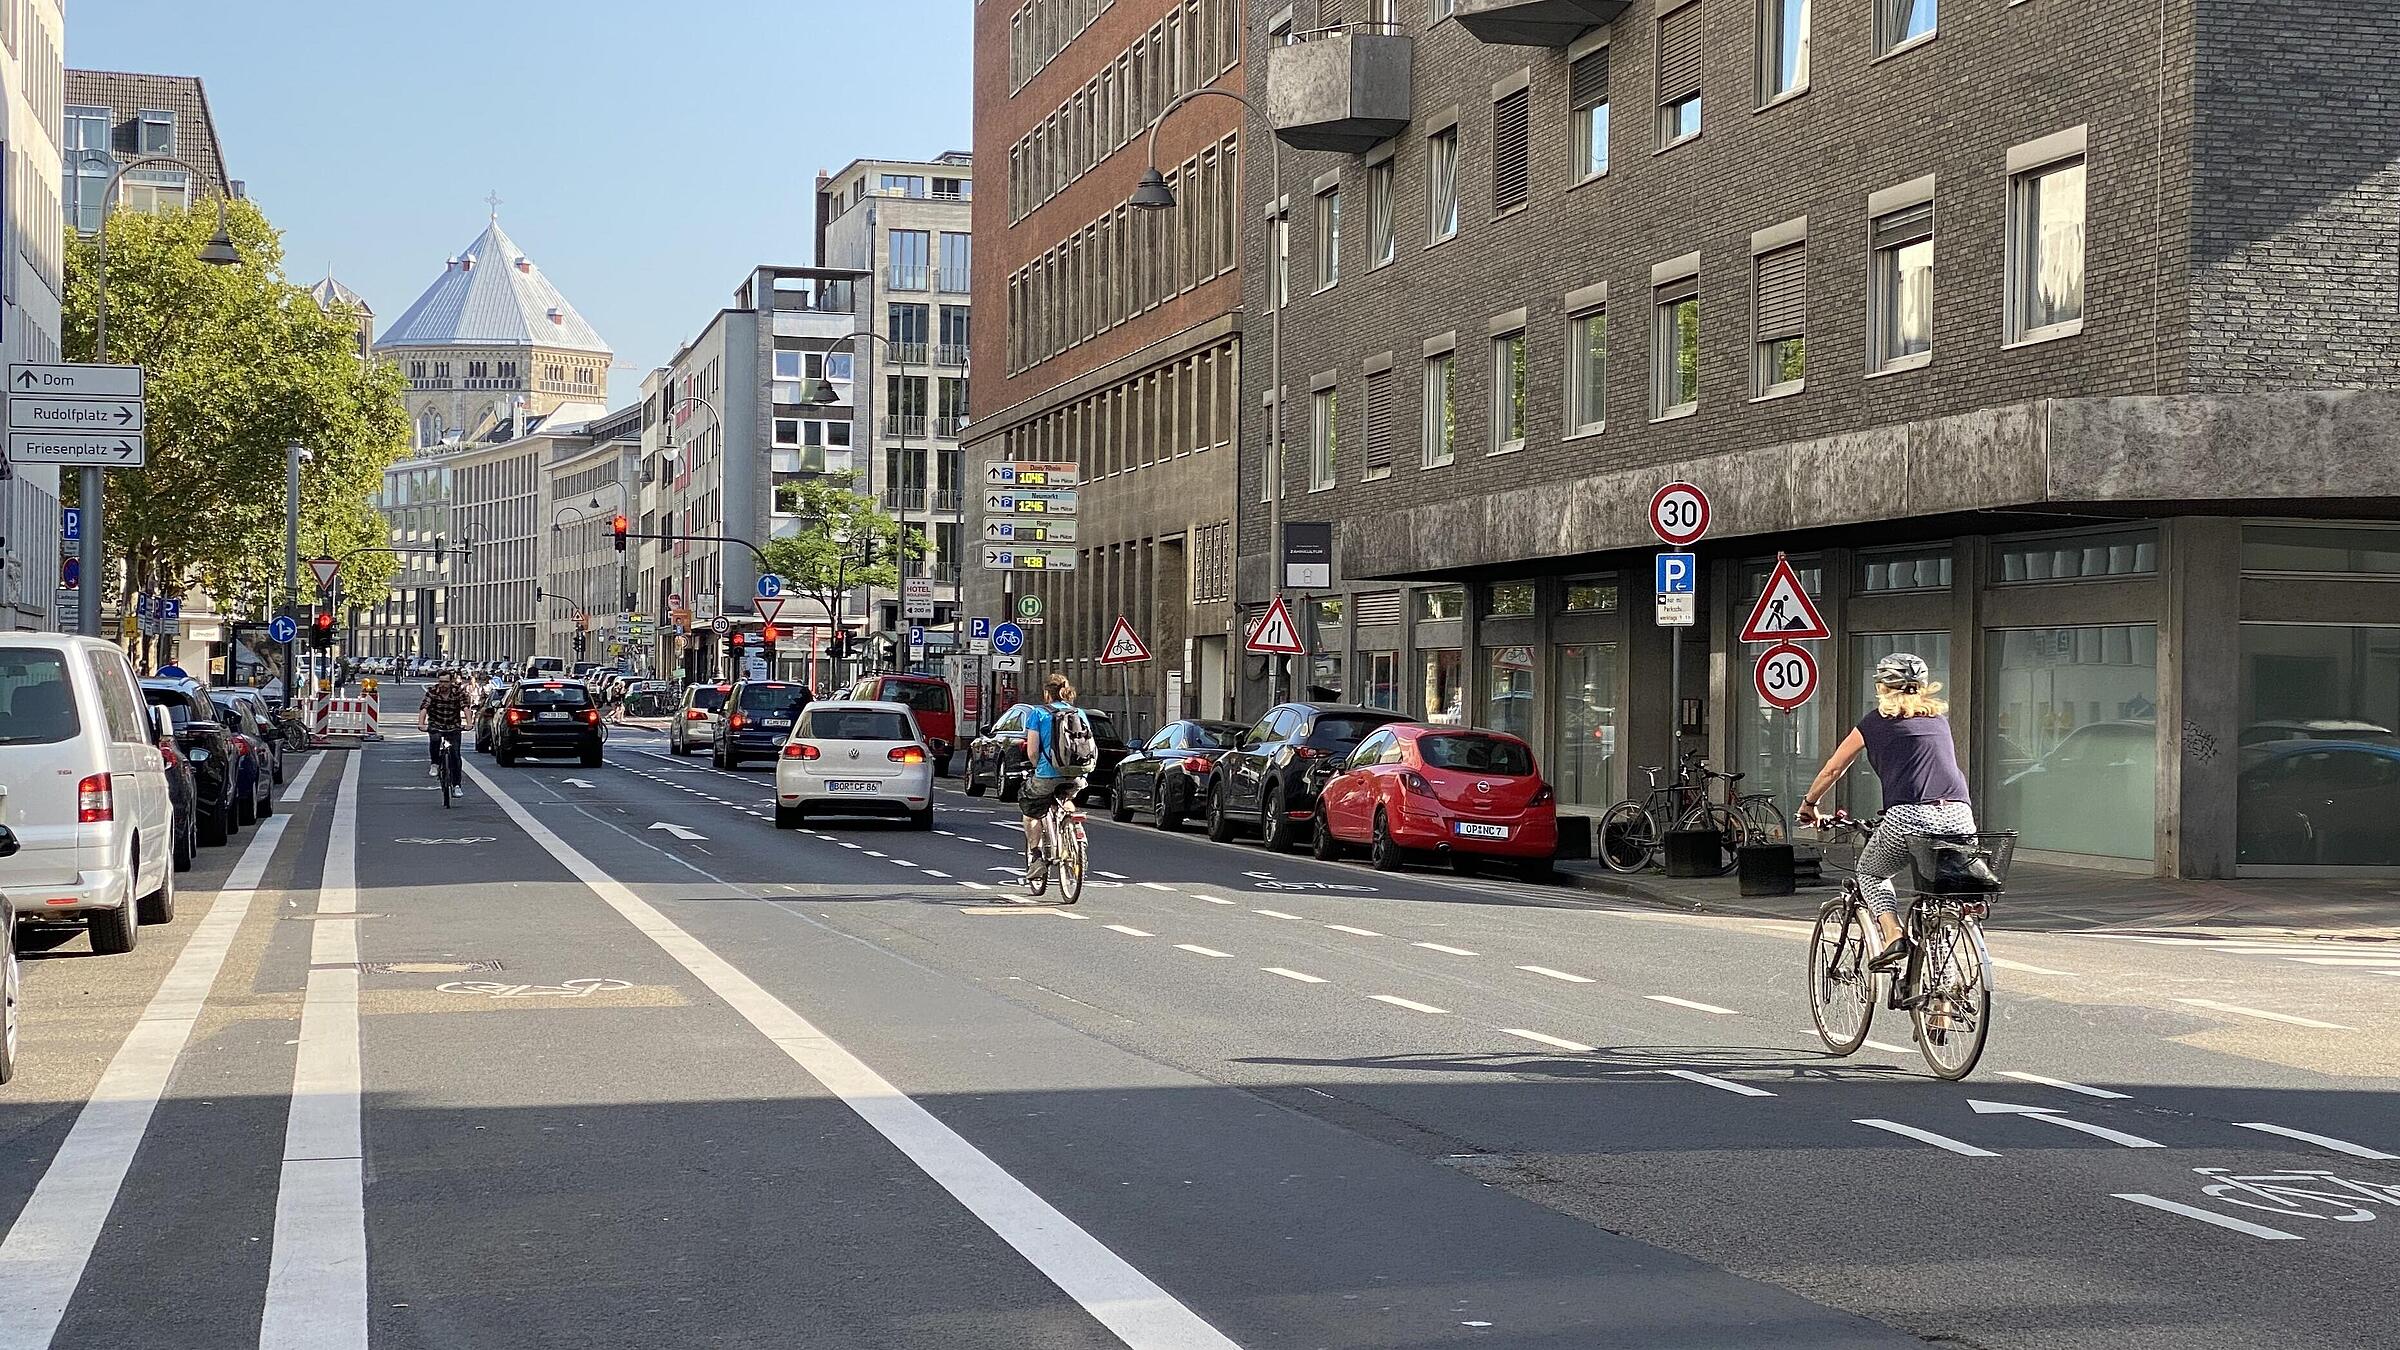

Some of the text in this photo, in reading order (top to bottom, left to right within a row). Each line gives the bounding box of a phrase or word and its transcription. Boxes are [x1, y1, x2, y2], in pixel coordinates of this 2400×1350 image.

[43, 373, 74, 386] Dom
[33, 407, 108, 423] Rudolfplatz
[26, 442, 108, 457] Friesenplatz
[1019, 473, 1044, 484] 1046
[1018, 501, 1043, 511] 1246
[1663, 500, 1697, 527] 30
[67, 512, 78, 535] P
[1036, 520, 1051, 528] Ringe
[1036, 529, 1043, 539] 0
[1036, 548, 1051, 556] Ringe
[1023, 556, 1042, 567] 438
[1666, 559, 1686, 592] P
[1025, 601, 1035, 612] H
[715, 621, 726, 629] 30
[973, 620, 984, 636] P
[911, 629, 920, 644] P
[1768, 659, 1803, 690] 30
[834, 782, 877, 791] BOR CF 86
[1466, 824, 1502, 835] OP NC 7
